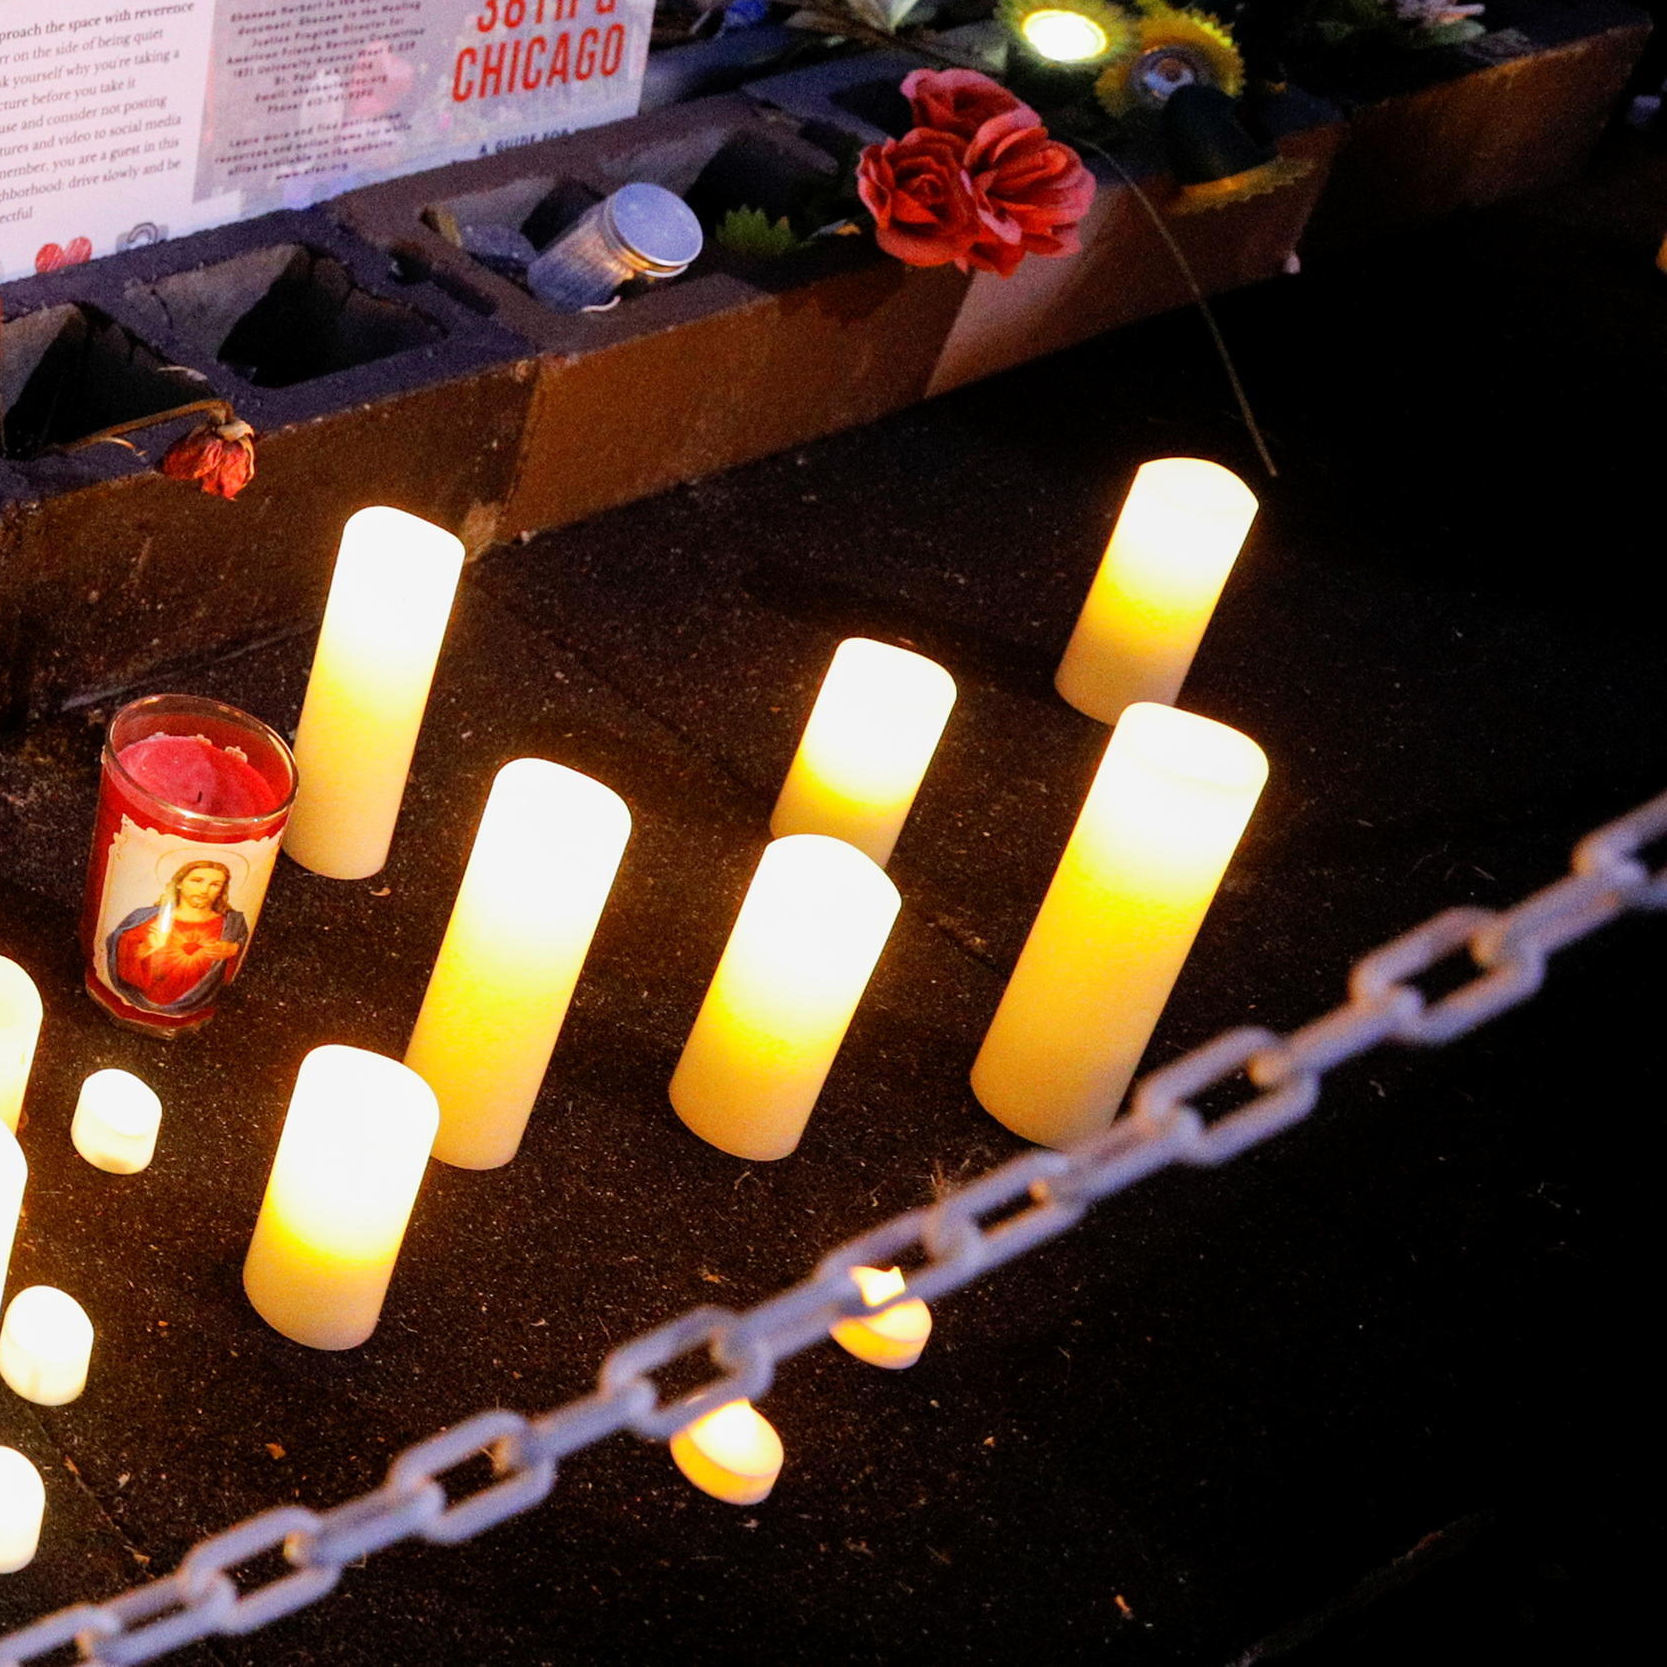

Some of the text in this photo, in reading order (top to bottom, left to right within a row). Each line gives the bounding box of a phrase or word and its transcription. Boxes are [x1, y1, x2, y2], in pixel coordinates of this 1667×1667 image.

[45, 20, 65, 34] the
[69, 17, 101, 33] space
[105, 9, 131, 24] with
[135, 2, 194, 19] reverence
[452, 24, 625, 103] CHICAGO
